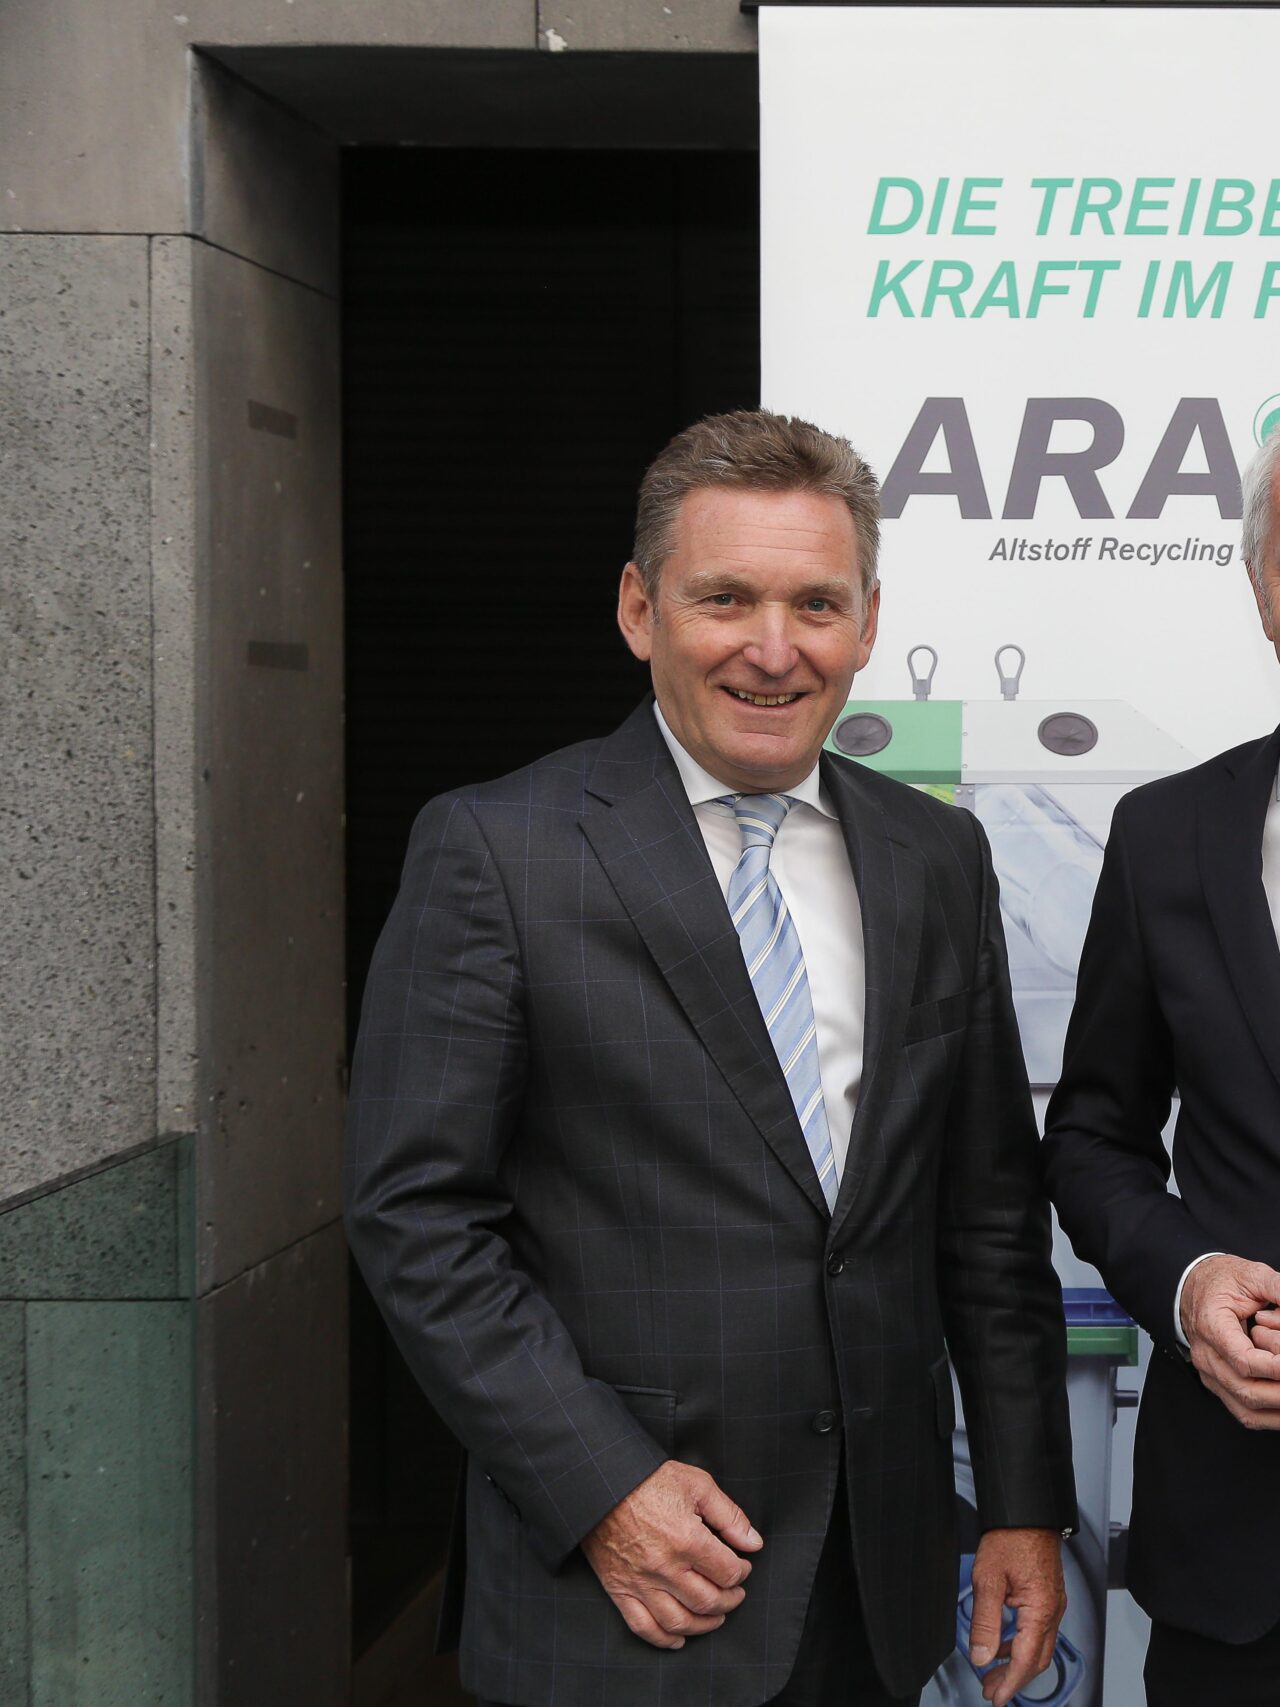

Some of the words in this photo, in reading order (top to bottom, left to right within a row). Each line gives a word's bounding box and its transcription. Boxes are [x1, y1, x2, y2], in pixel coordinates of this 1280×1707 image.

[865, 176, 1004, 236] DIE
[865, 258, 1121, 320] KRAFT
[1136, 259, 1233, 320] IM
[878, 396, 1243, 520] ARA
[987, 536, 1094, 562] Altstoff
[1096, 536, 1235, 567] Recycling
